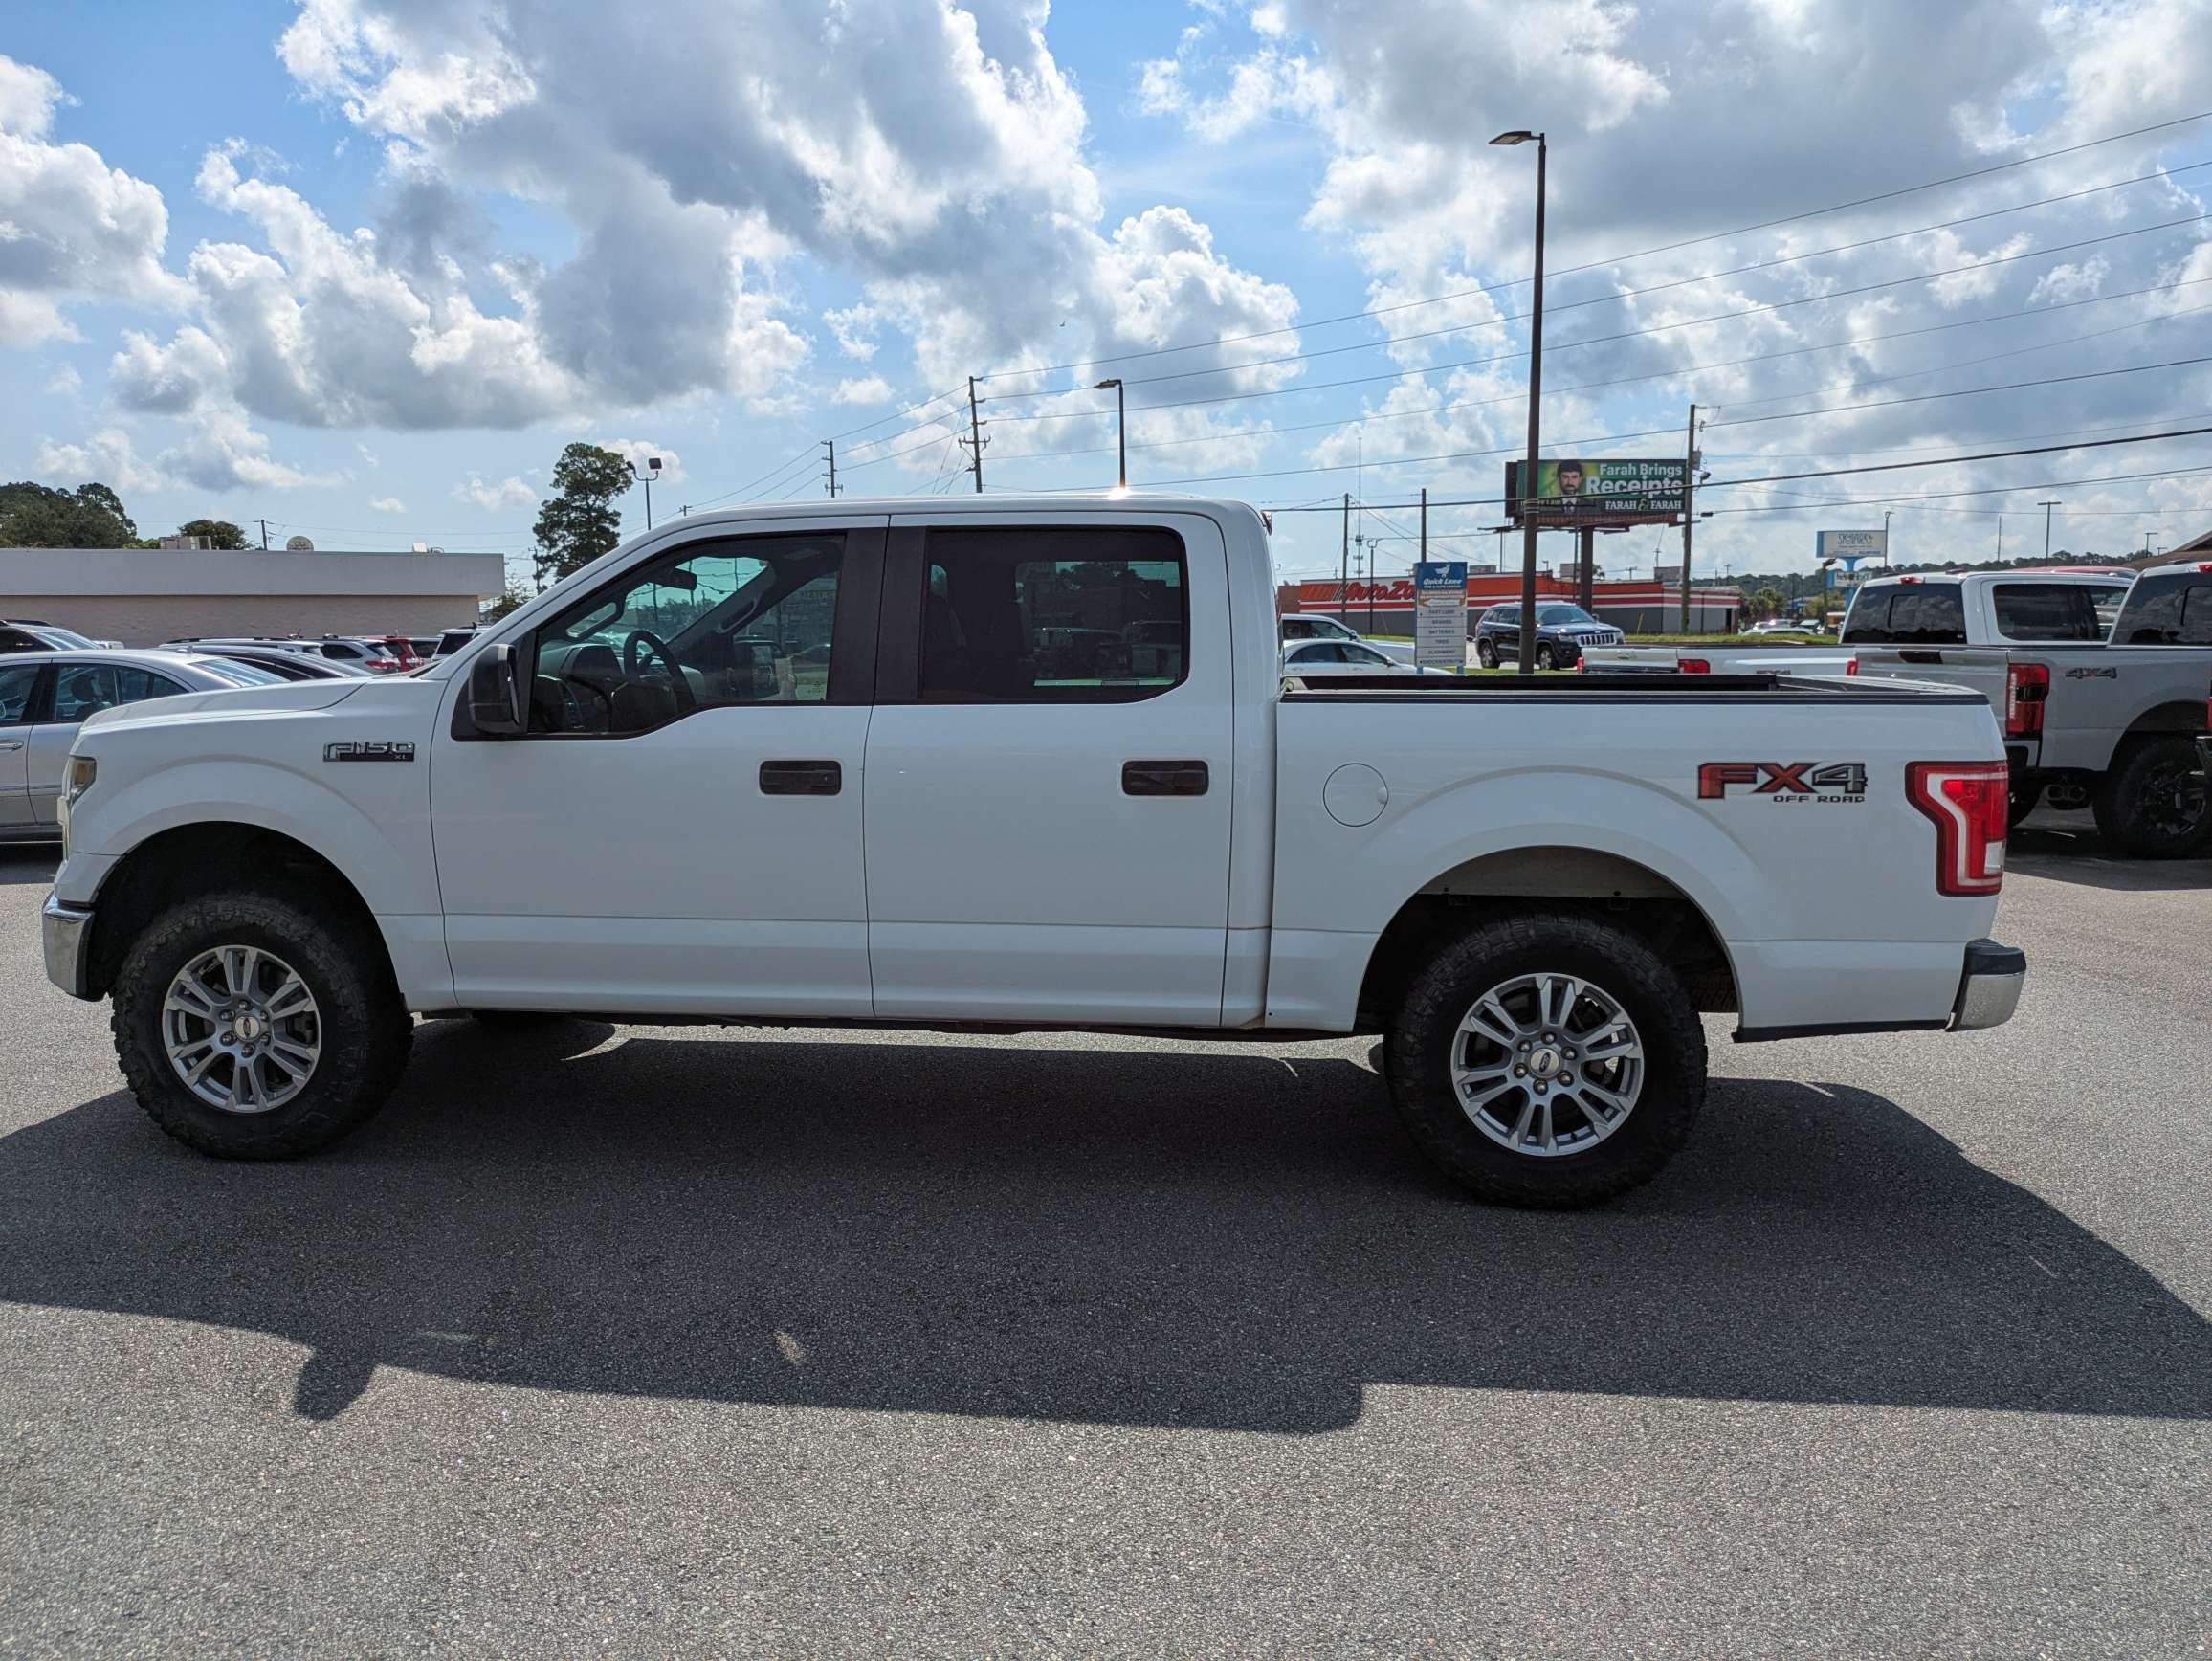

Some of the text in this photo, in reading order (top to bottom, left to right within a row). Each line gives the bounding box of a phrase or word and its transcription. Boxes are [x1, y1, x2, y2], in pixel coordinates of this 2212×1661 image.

[1600, 463, 1682, 477] Farah Brings
[1586, 476, 1683, 498] Receipts
[1605, 500, 1637, 510] FARAH
[1650, 500, 1681, 510] FARAH
[1697, 763, 1868, 800] FX4
